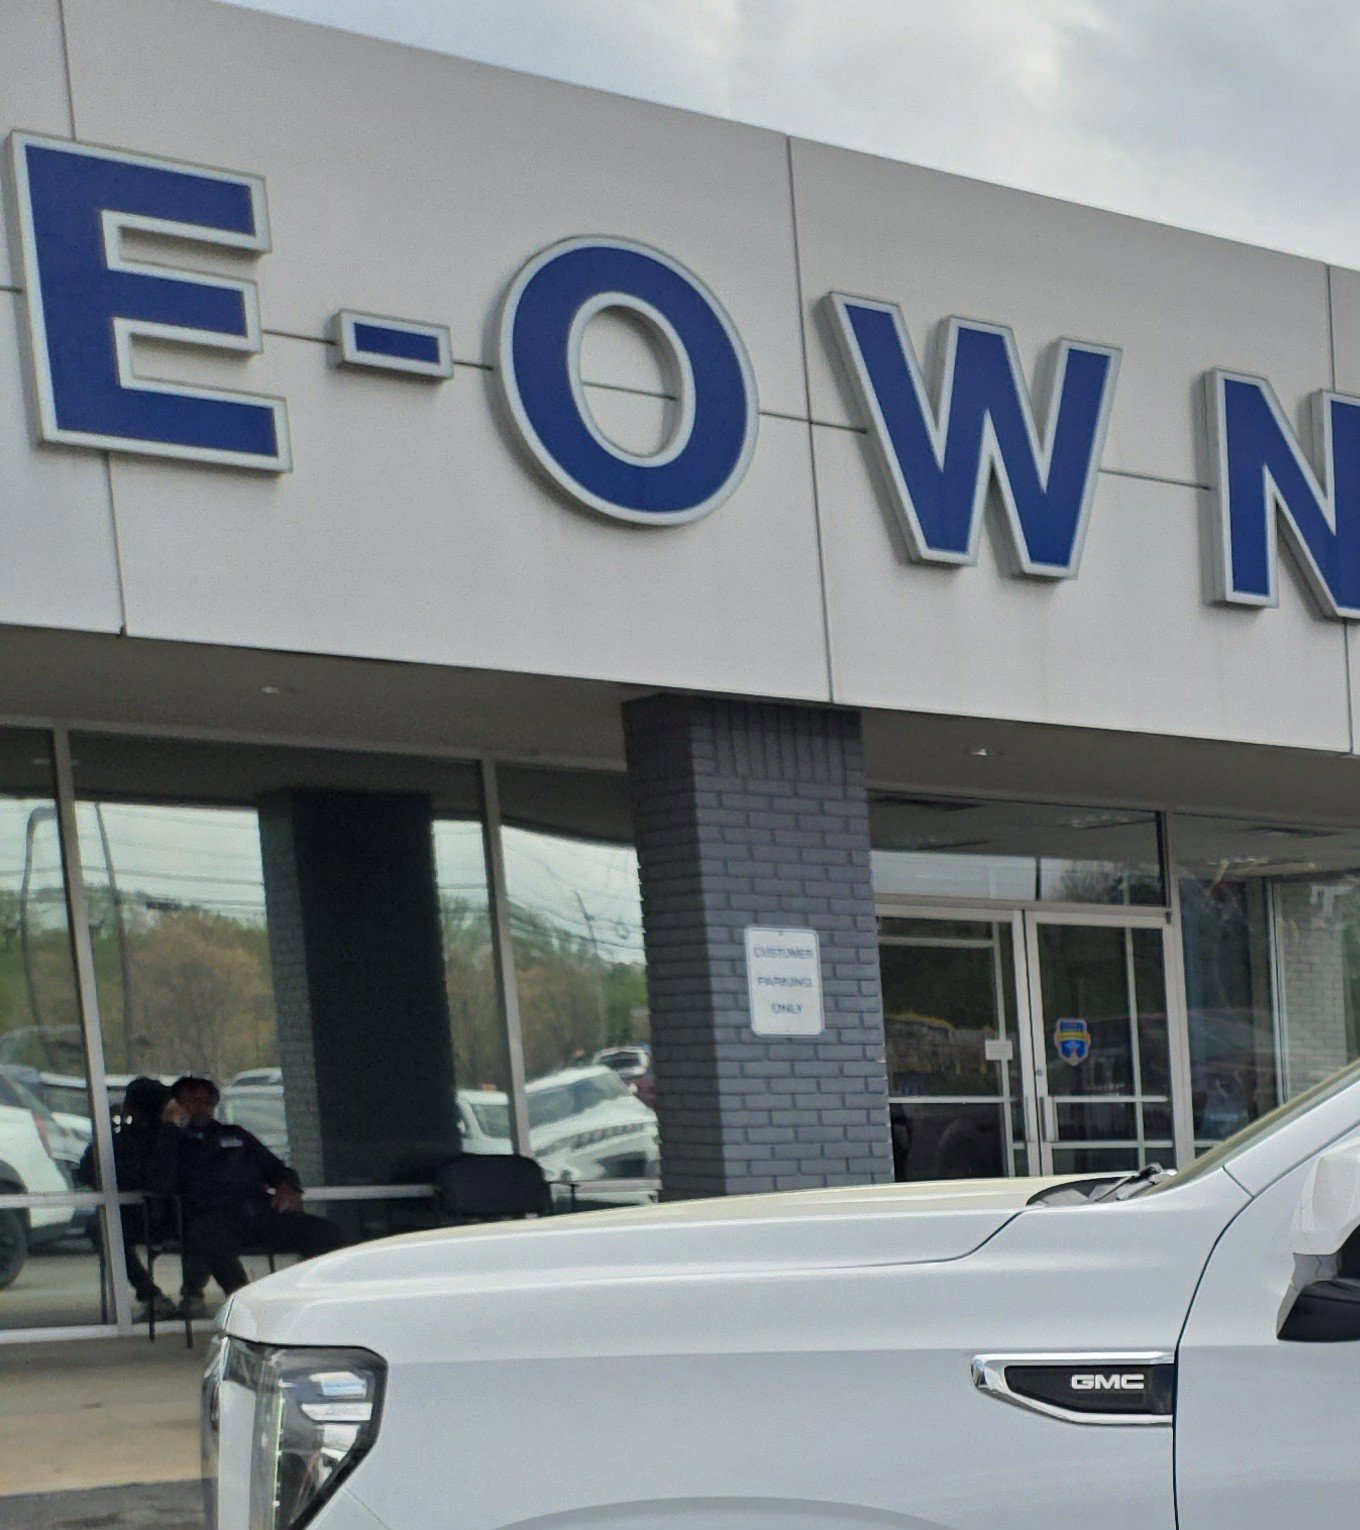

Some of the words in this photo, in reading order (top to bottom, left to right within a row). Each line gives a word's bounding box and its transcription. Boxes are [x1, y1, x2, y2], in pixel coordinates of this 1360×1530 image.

[757, 976, 812, 988] PARKING
[771, 1003, 804, 1015] ONLY
[1071, 1374, 1144, 1390] GMC
